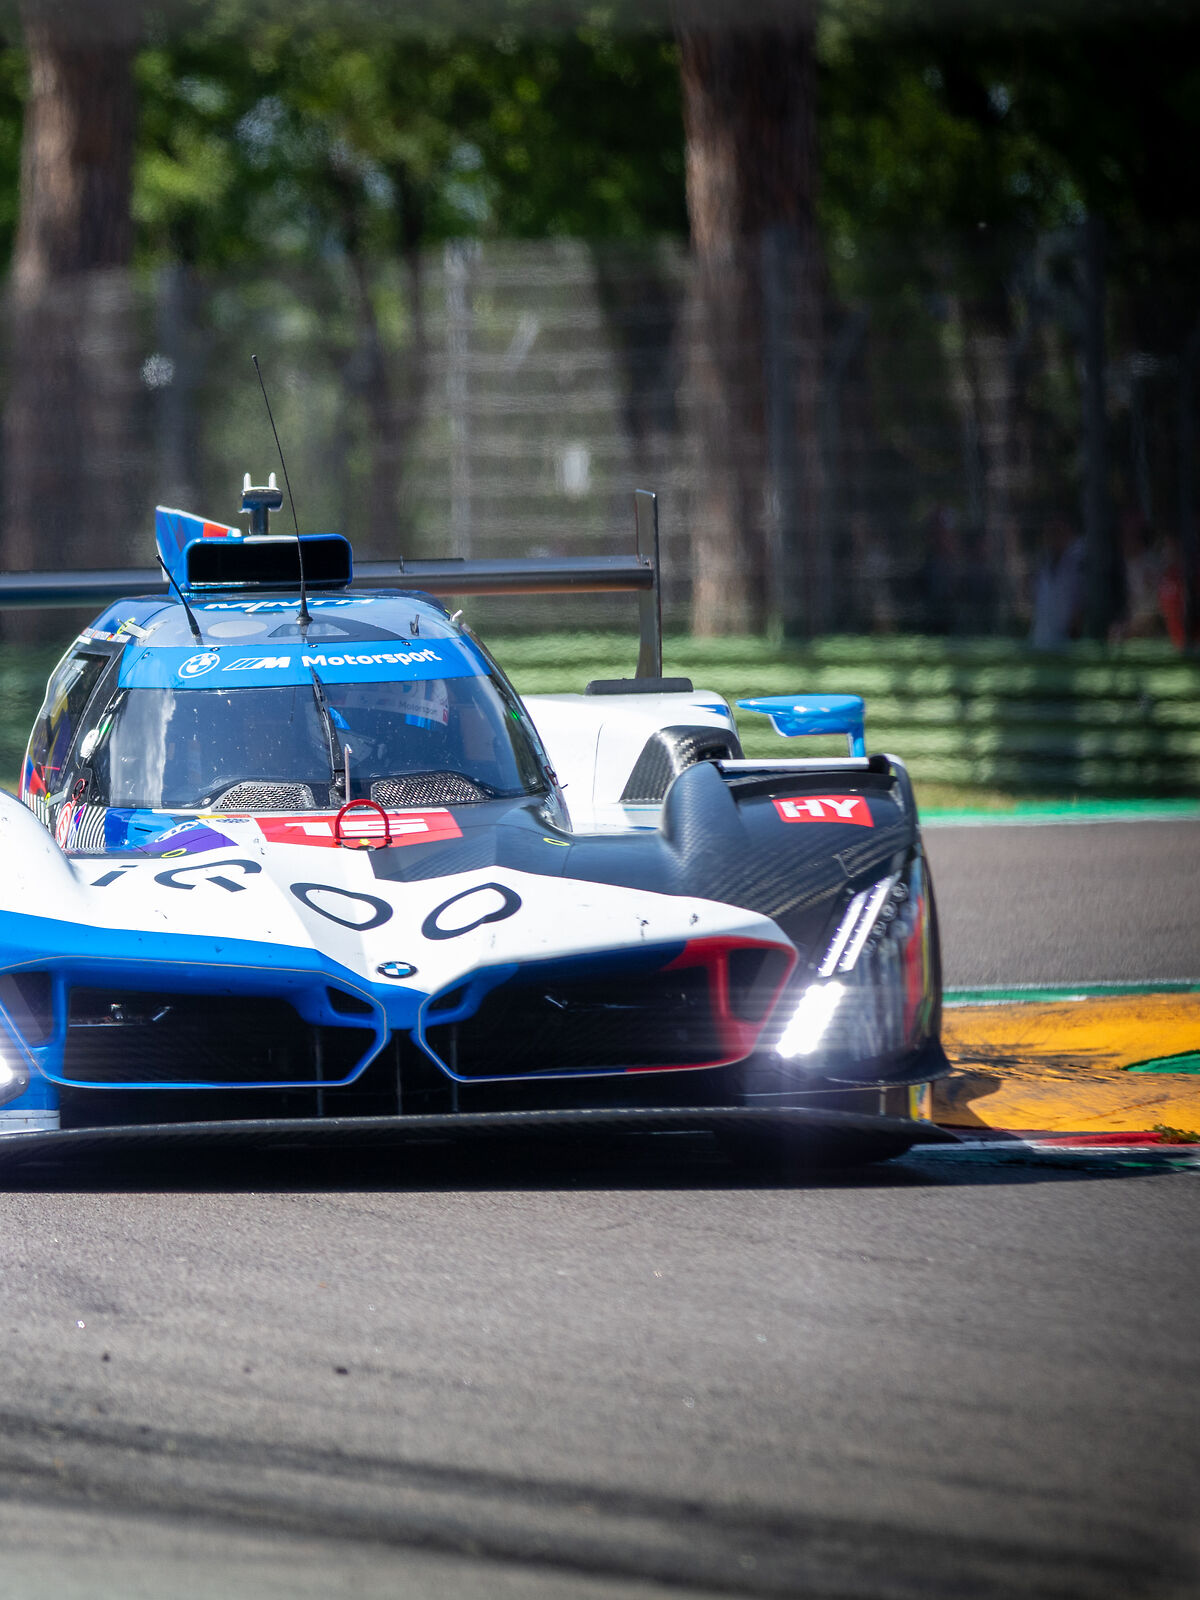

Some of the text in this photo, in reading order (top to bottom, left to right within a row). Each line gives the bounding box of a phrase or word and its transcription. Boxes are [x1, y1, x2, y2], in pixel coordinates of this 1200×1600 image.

[301, 648, 443, 667] Motorsport
[779, 799, 860, 818] HY
[284, 818, 429, 837] 15
